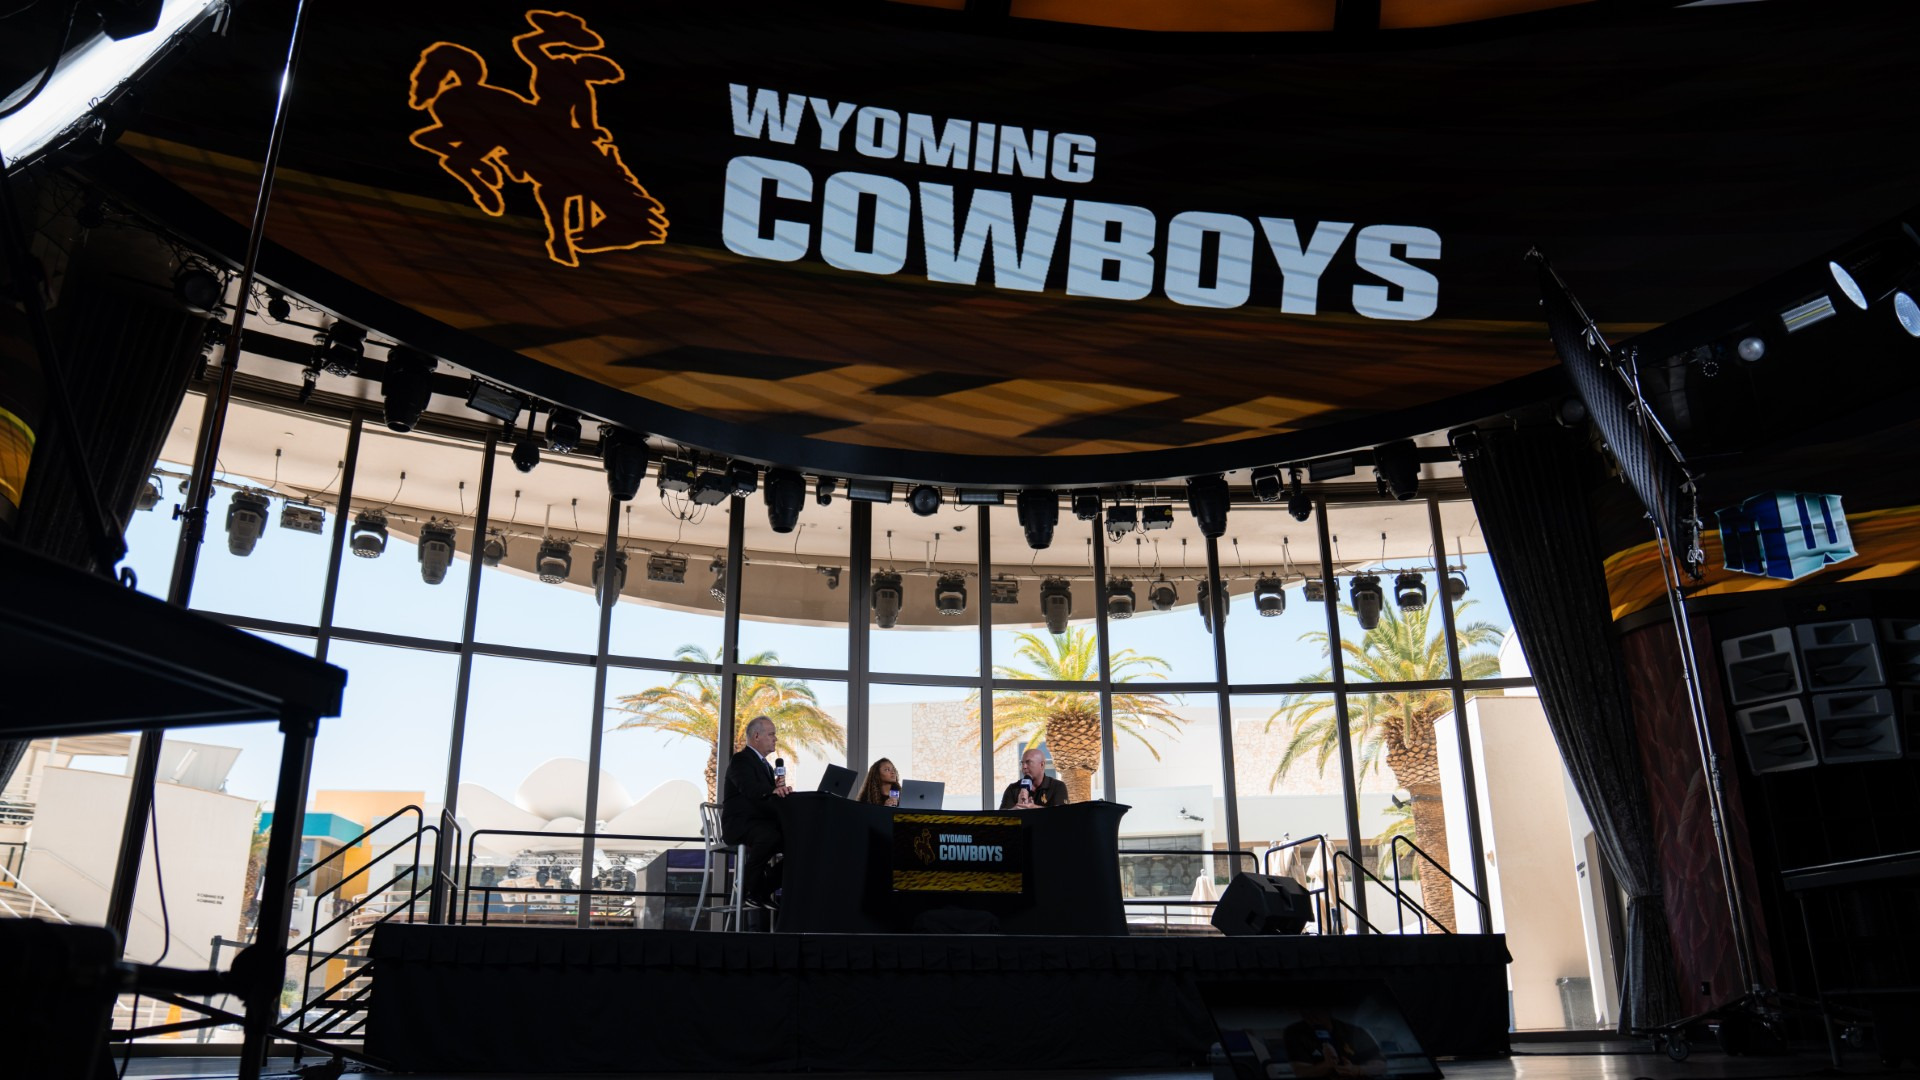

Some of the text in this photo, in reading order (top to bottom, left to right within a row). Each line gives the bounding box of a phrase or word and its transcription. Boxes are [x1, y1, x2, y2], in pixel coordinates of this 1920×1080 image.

[729, 83, 1097, 183] WYOMING
[721, 155, 1442, 321] COWBOYS
[939, 833, 973, 843] WYOMING
[939, 844, 1003, 862] COWBOYS
